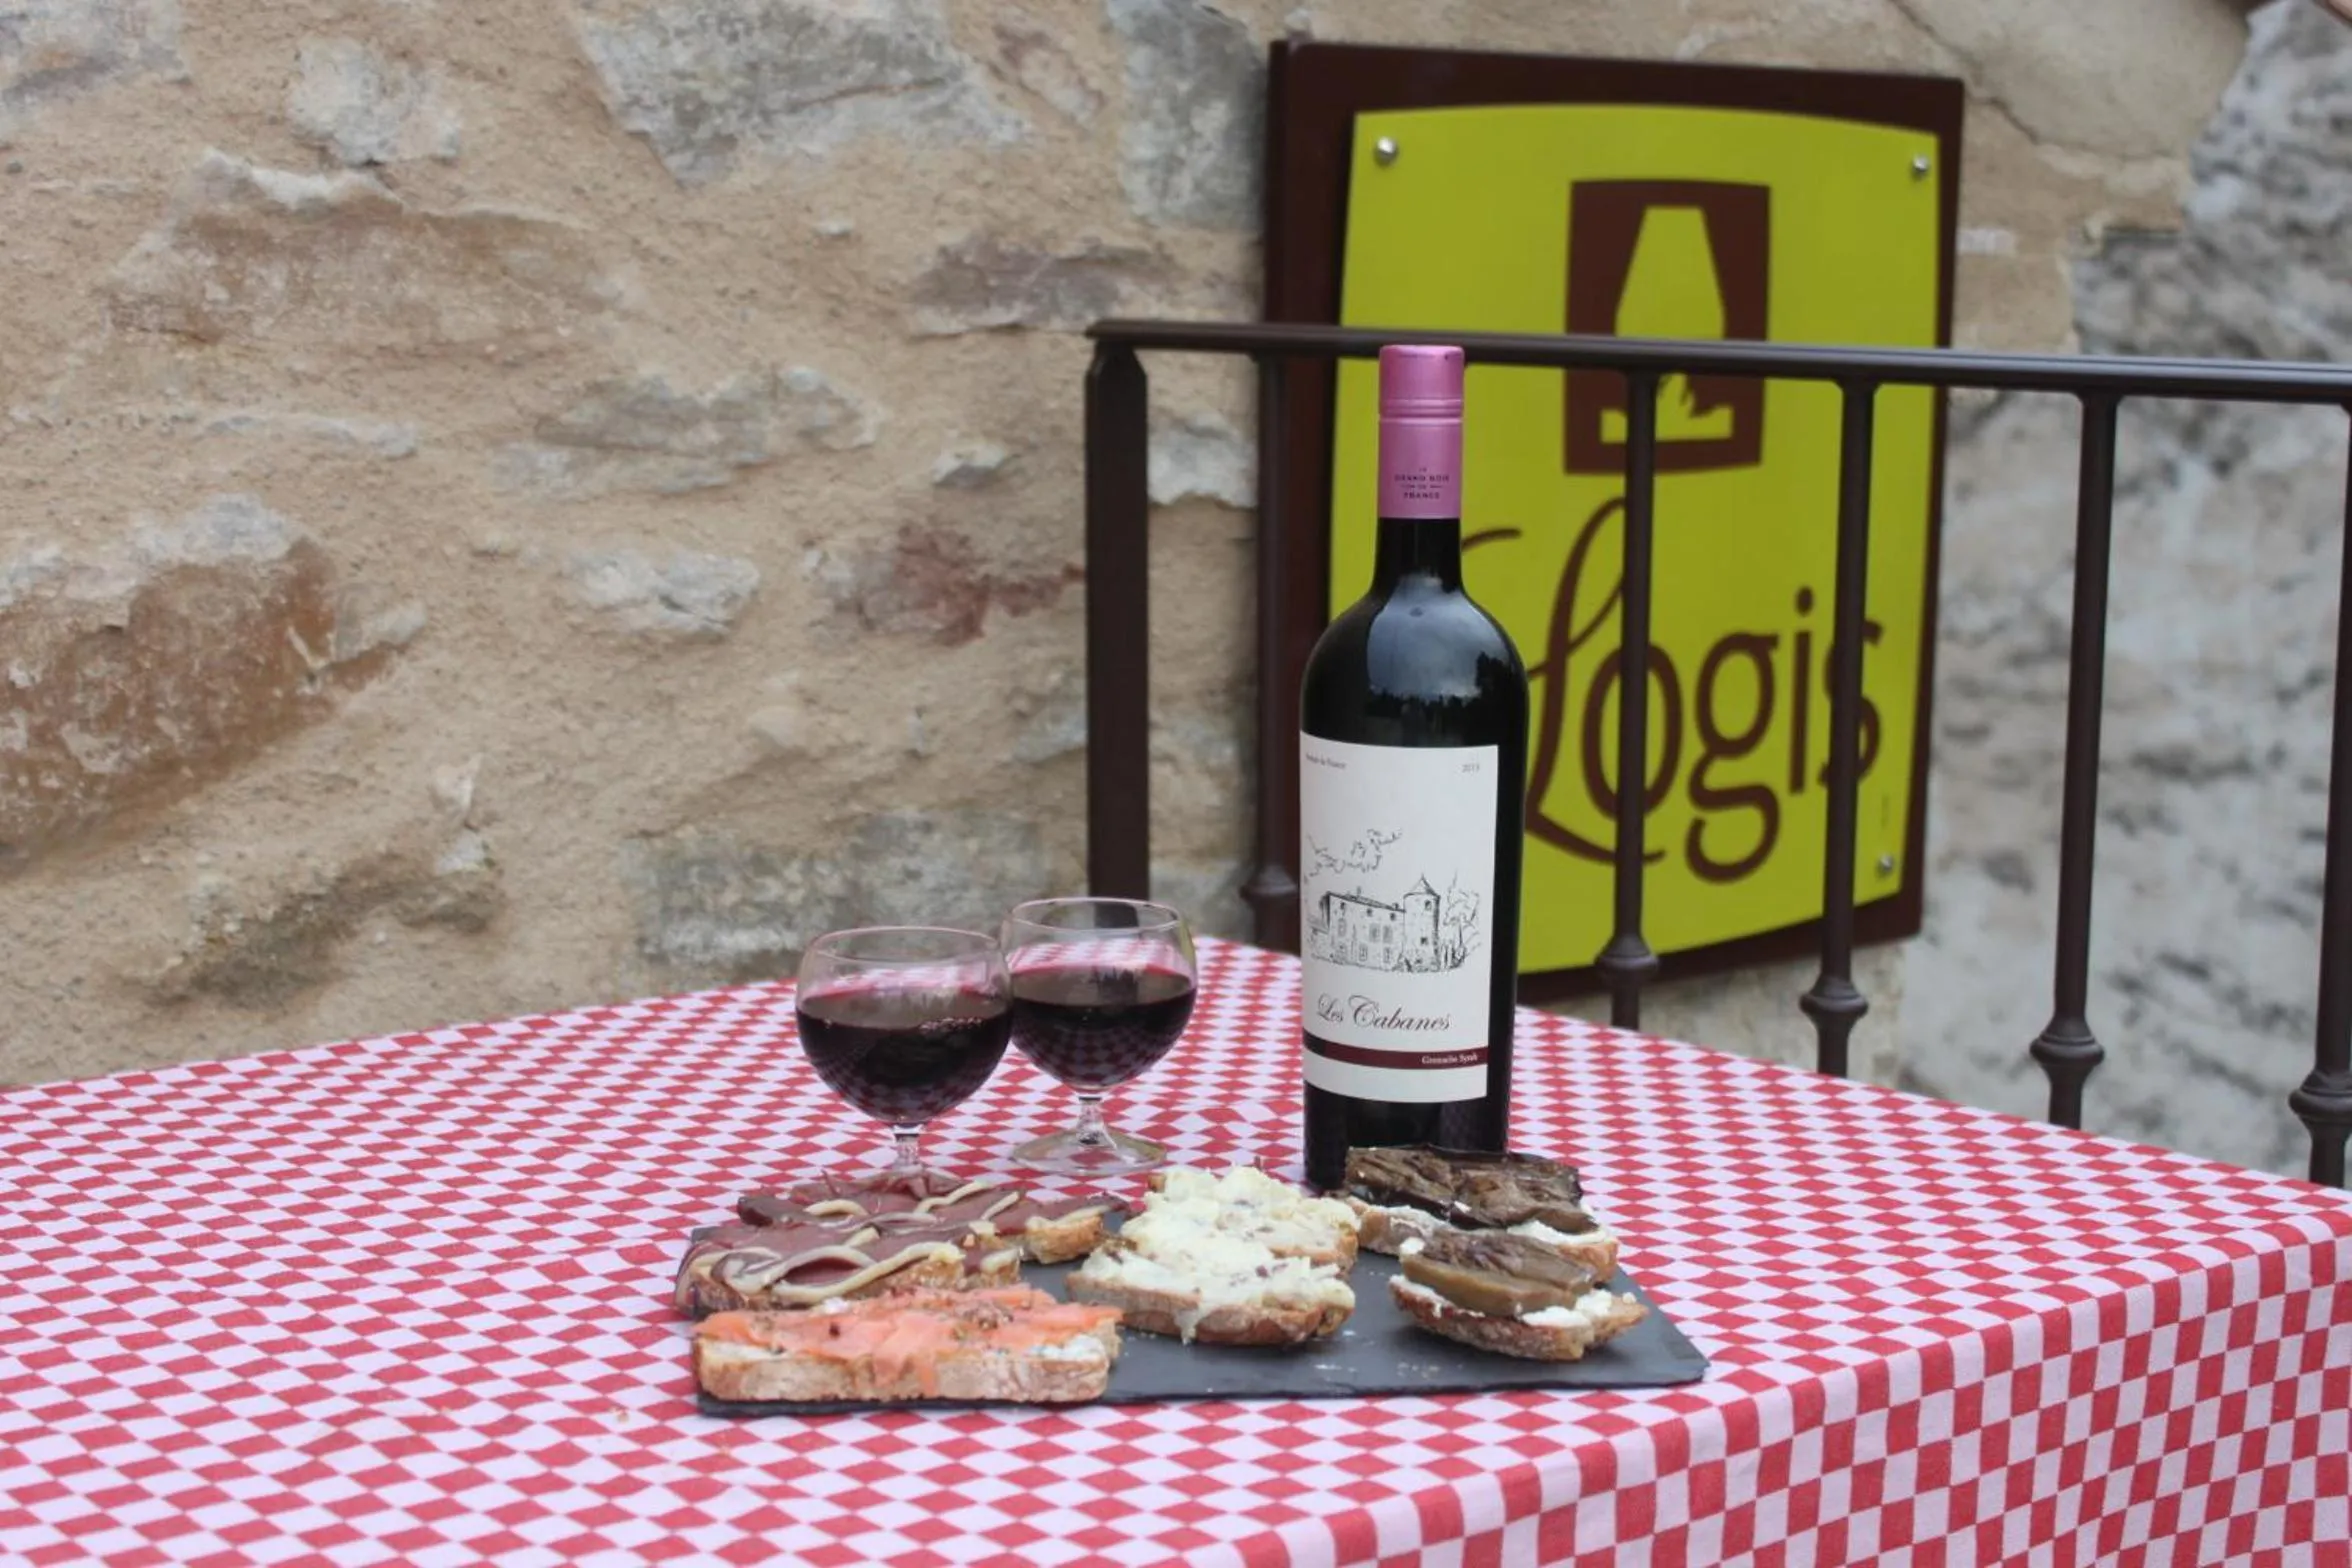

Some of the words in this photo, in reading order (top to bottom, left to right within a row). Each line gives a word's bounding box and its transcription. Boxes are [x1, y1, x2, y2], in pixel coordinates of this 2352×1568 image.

[1403, 491, 1440, 499] FRANCE
[1461, 497, 1882, 884] Logis
[1316, 992, 1344, 1023] Les
[1348, 995, 1453, 1032] Cabanes
